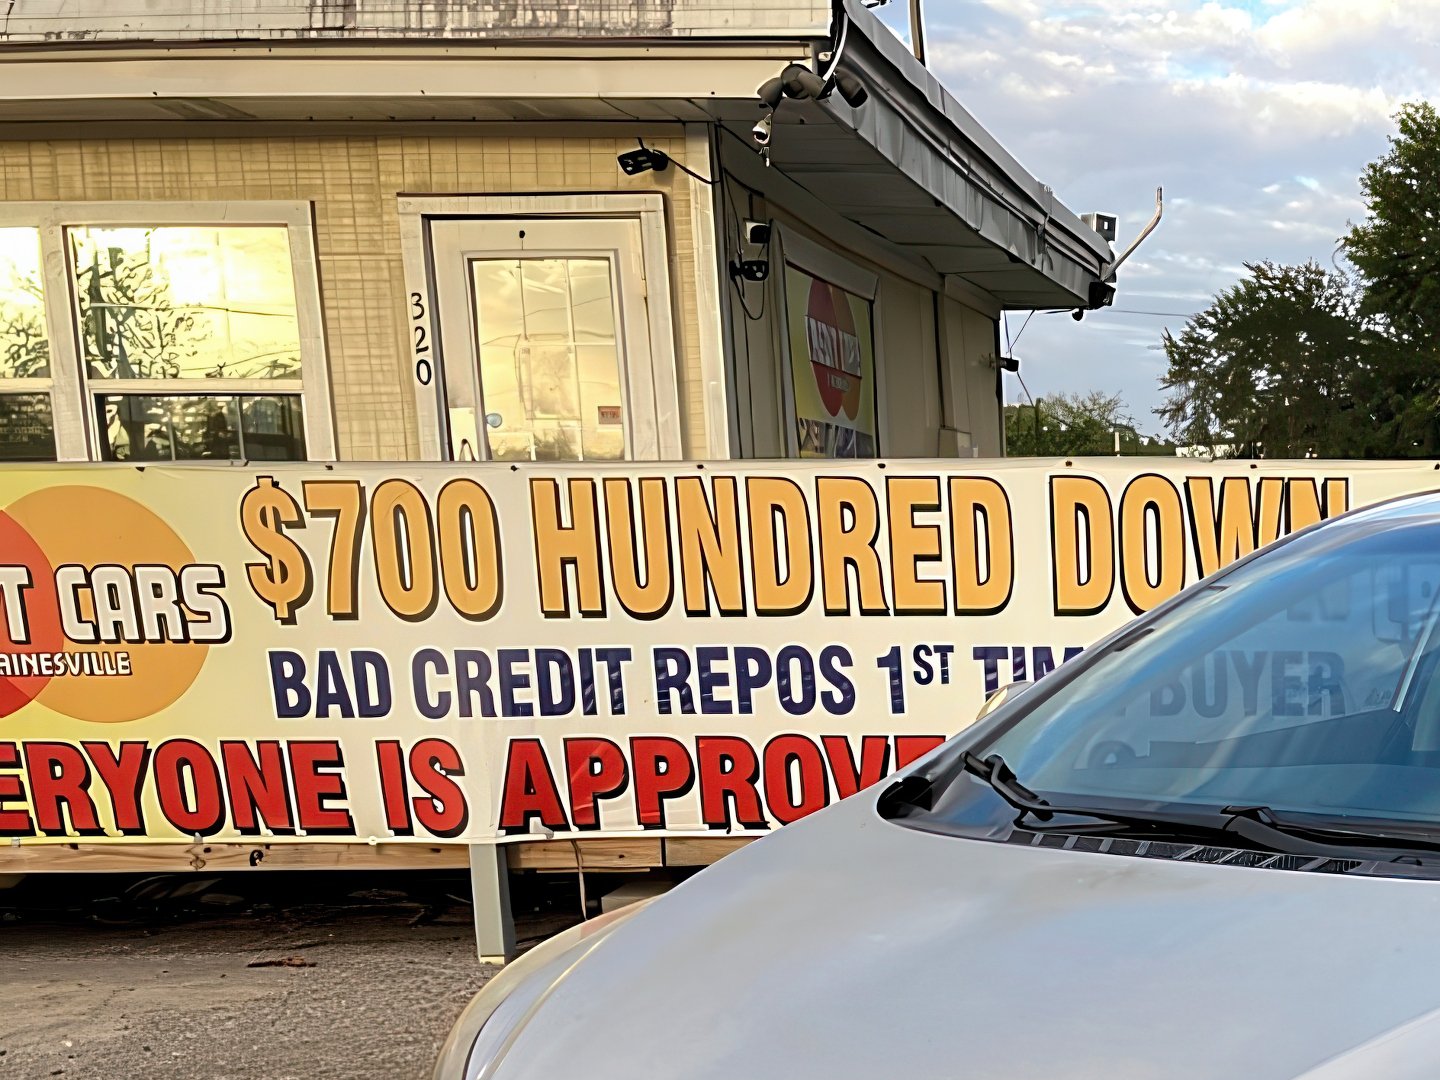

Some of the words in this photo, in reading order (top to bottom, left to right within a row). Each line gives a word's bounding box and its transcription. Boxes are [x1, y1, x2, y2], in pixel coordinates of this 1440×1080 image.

[411, 292, 432, 386] 320
[240, 475, 501, 627] $700
[529, 475, 1014, 620] HUNDRED
[55, 563, 232, 644] CARS
[269, 650, 391, 719] BAD
[412, 647, 631, 719] CREDIT
[658, 645, 854, 716] REPOS
[877, 644, 954, 714] 1ST
[1150, 650, 1345, 718] BUYER
[376, 738, 469, 837] IS
[499, 735, 947, 834] APPROV
